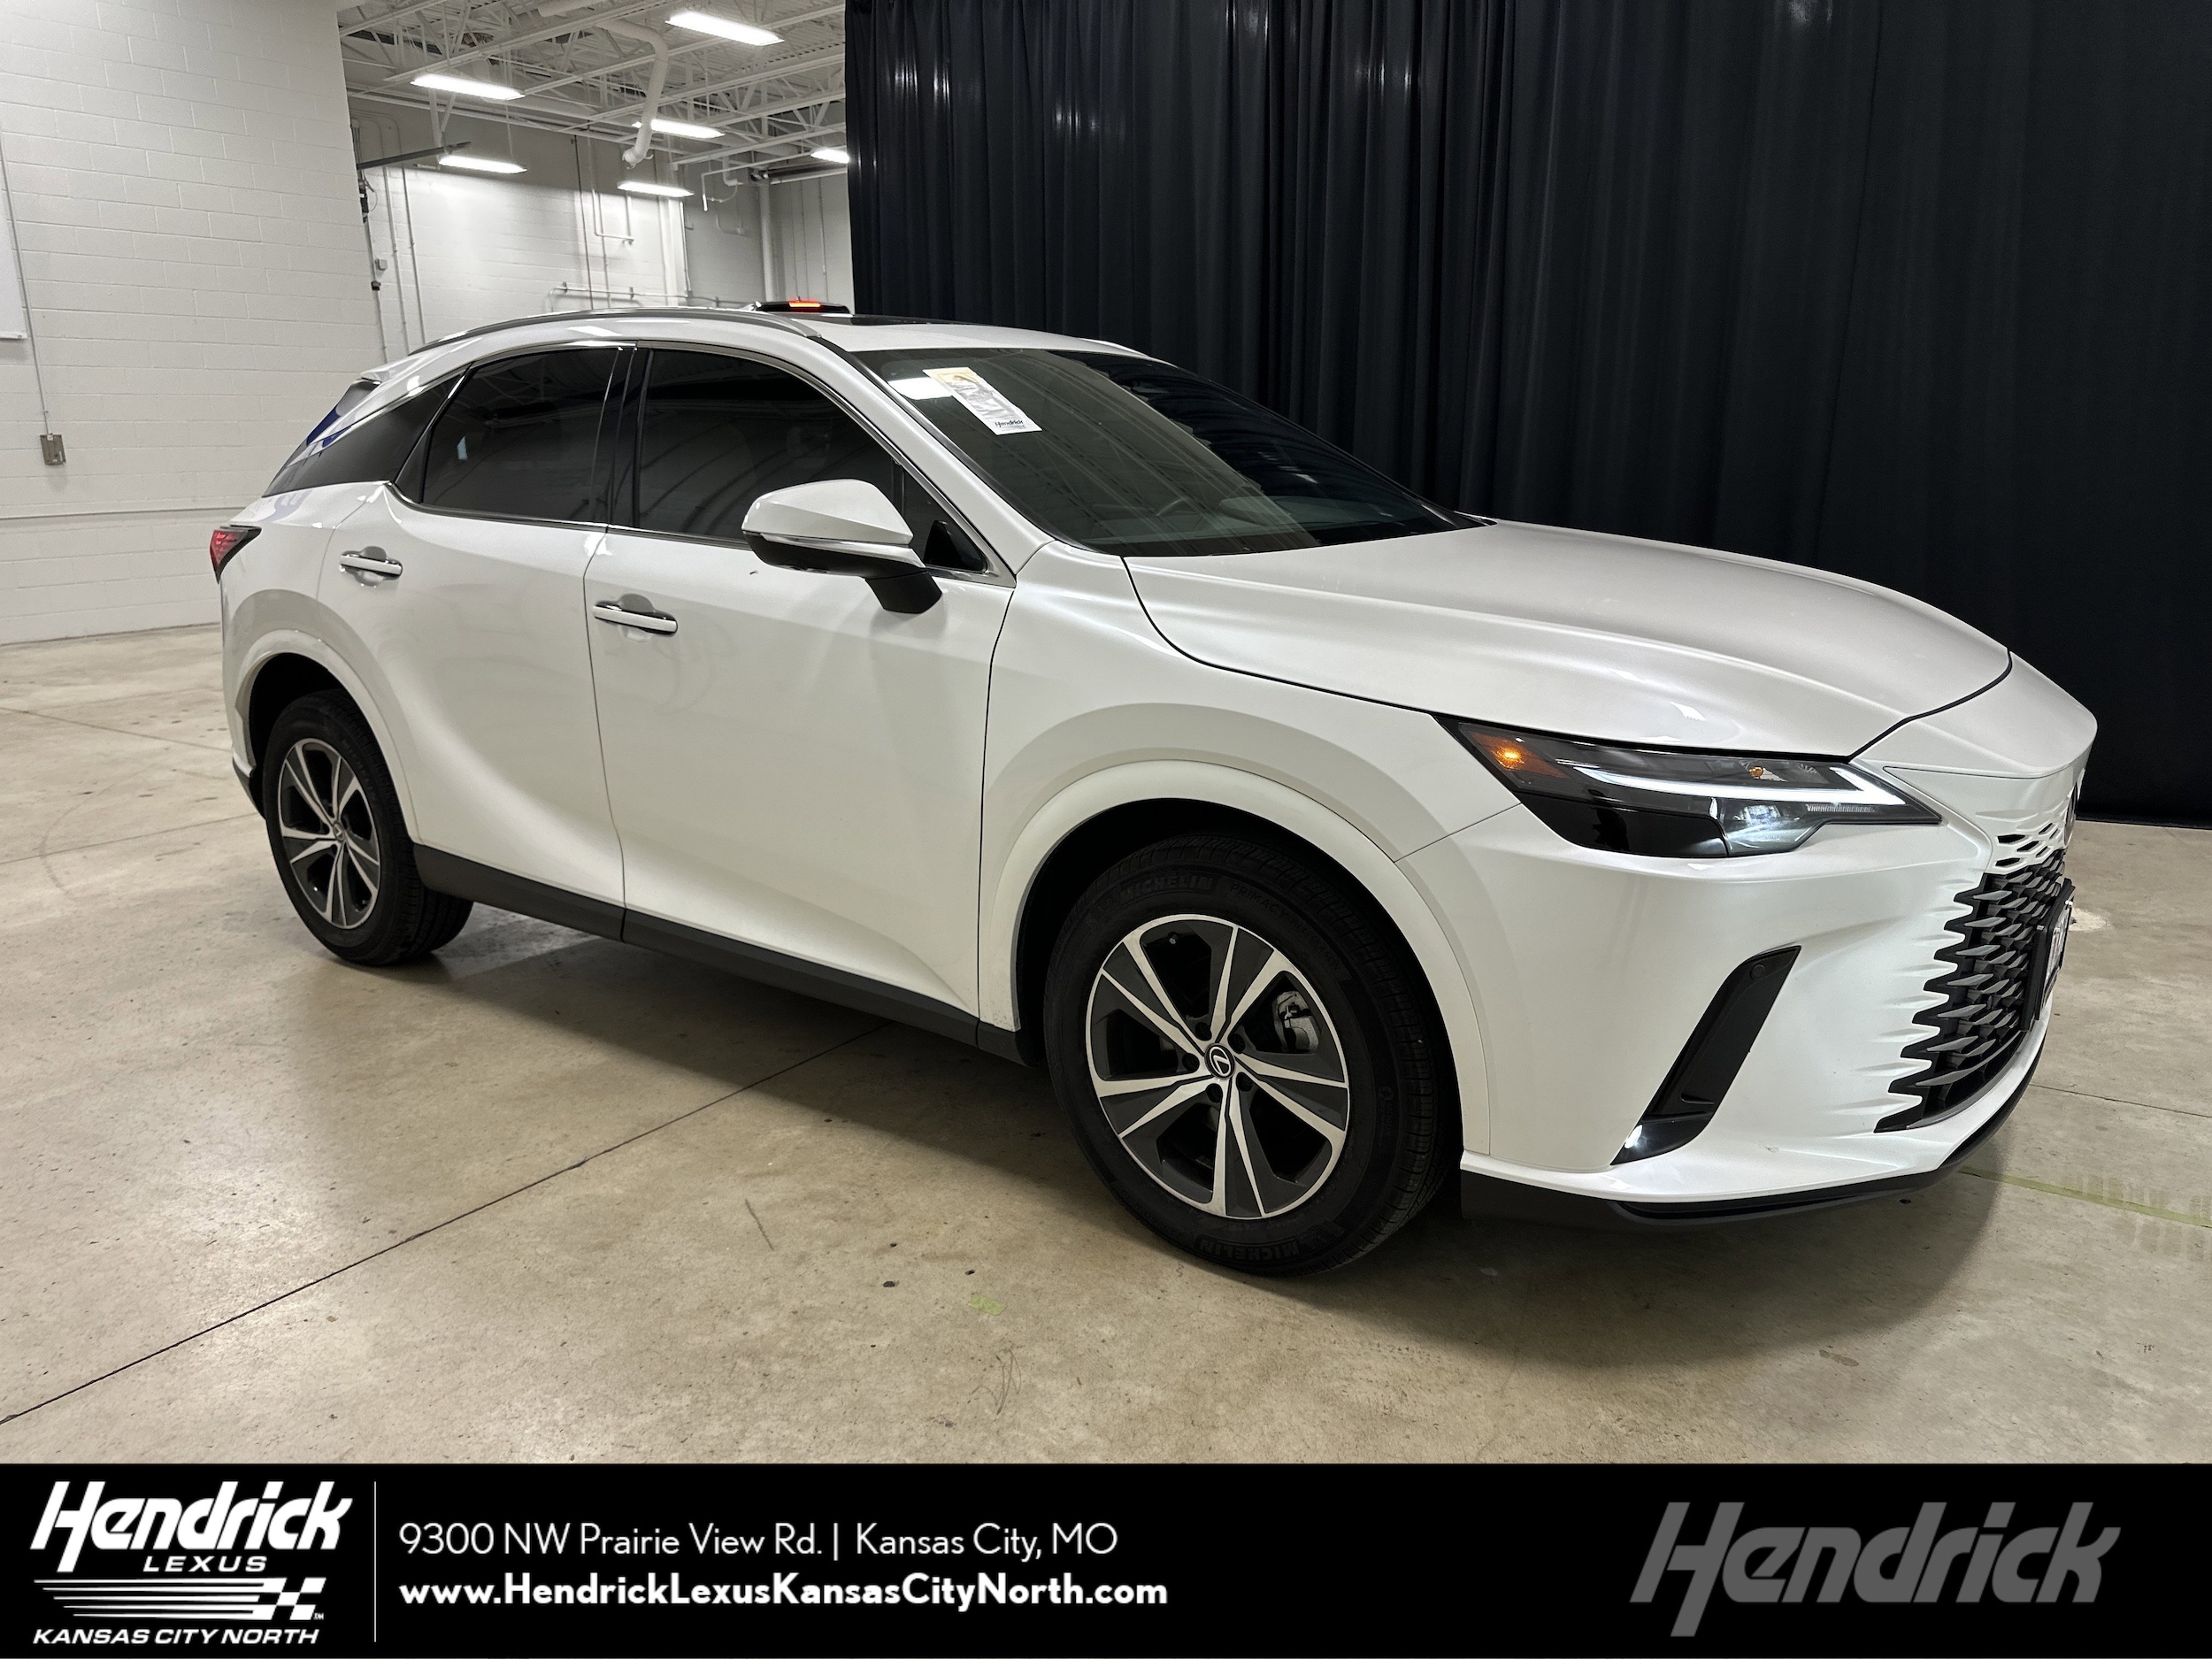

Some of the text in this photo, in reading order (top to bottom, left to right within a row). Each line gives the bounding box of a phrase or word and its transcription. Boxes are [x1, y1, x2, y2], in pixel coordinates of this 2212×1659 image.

[1120, 873, 1214, 901] MICHELIN
[1229, 883, 1290, 918] PRIMACY
[1199, 1238, 1301, 1261] MICHELIN
